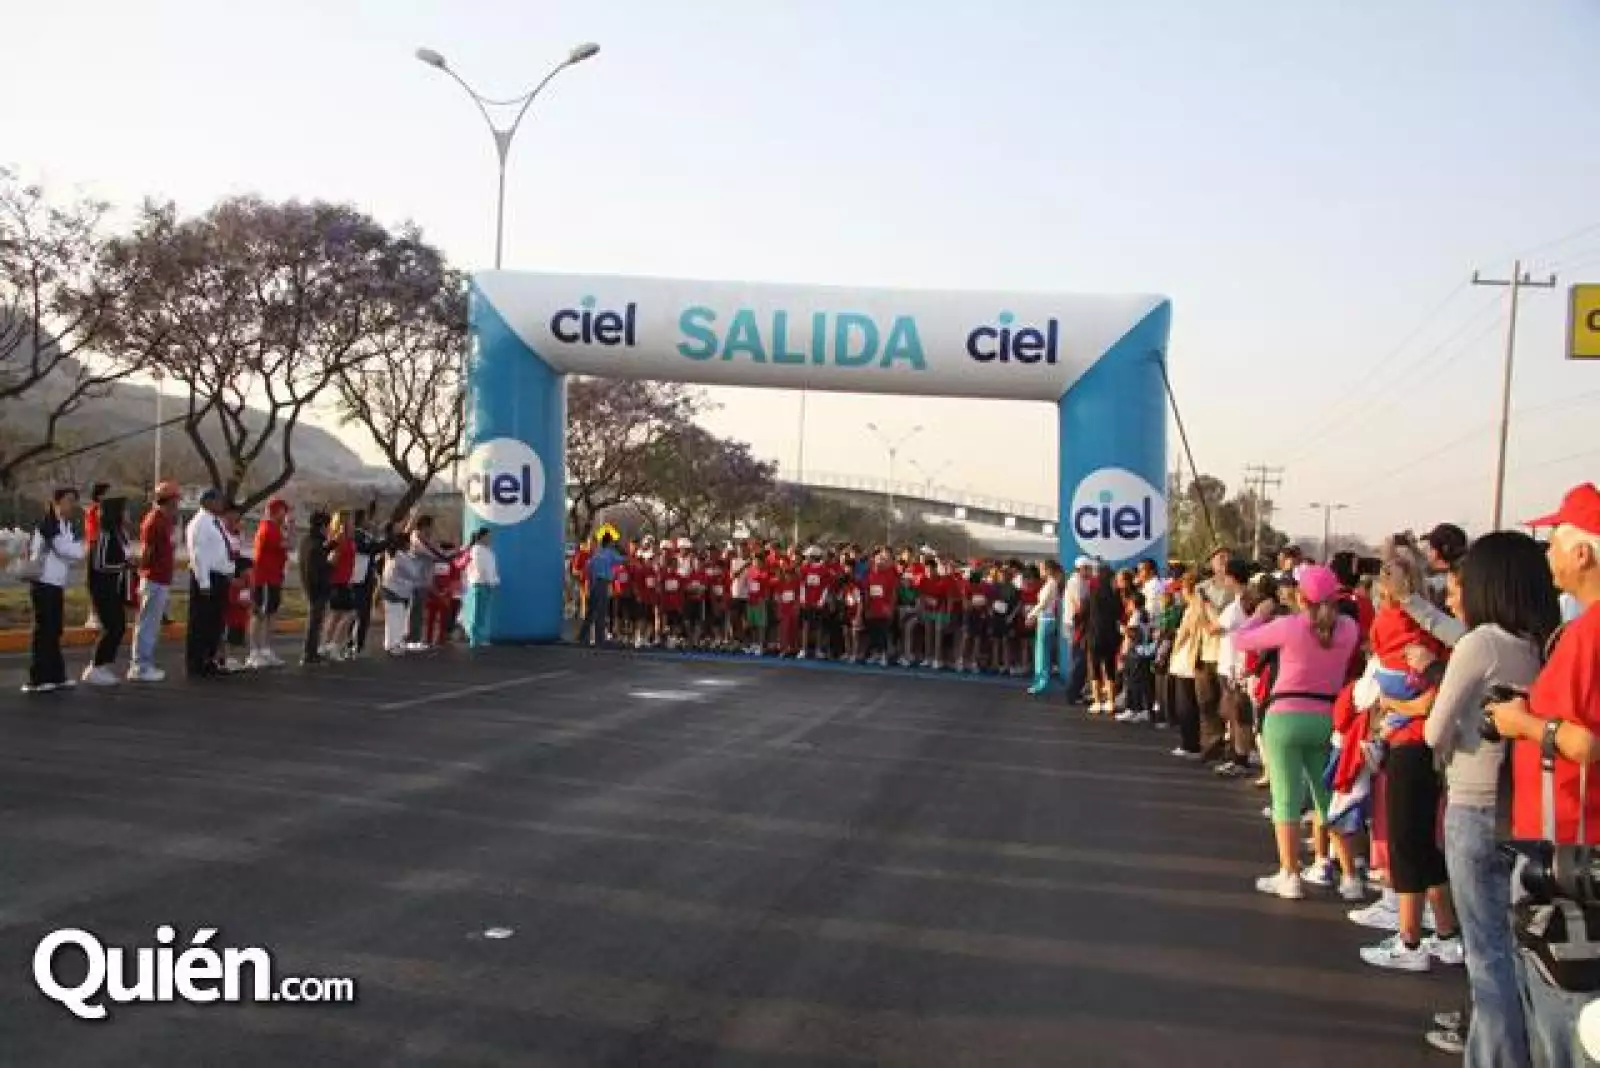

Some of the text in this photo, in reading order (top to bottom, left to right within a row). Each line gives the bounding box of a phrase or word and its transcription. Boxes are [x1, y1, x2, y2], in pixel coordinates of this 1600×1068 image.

[551, 295, 636, 347] ciel
[677, 306, 927, 371] SALIDA
[967, 310, 1058, 365] ciel
[467, 459, 531, 506] ciel
[1074, 489, 1151, 541] ciel
